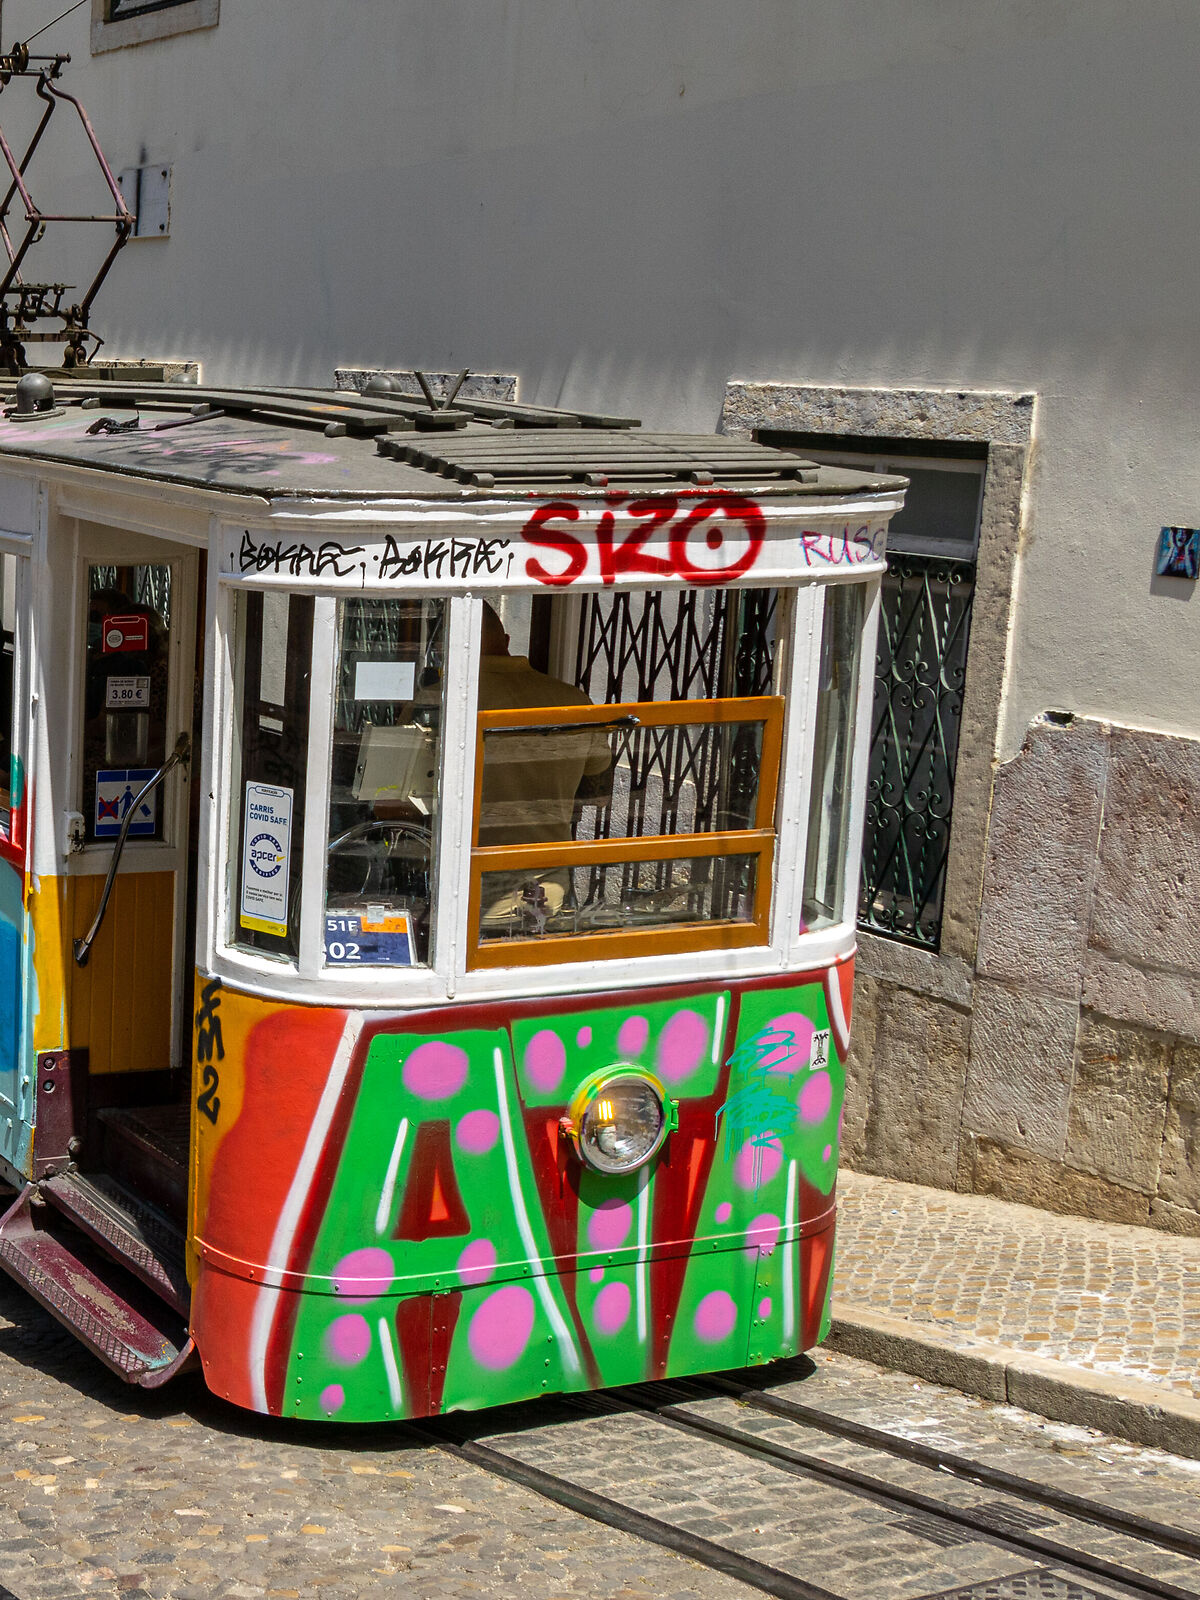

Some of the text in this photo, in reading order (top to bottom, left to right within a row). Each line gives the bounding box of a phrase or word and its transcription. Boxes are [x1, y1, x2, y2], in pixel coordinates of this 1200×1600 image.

[112, 689, 133, 699] 3.80
[249, 803, 274, 815] CARRIS
[249, 812, 288, 826] COVID SAFE
[251, 849, 277, 862] apcer
[329, 942, 361, 960] 02
